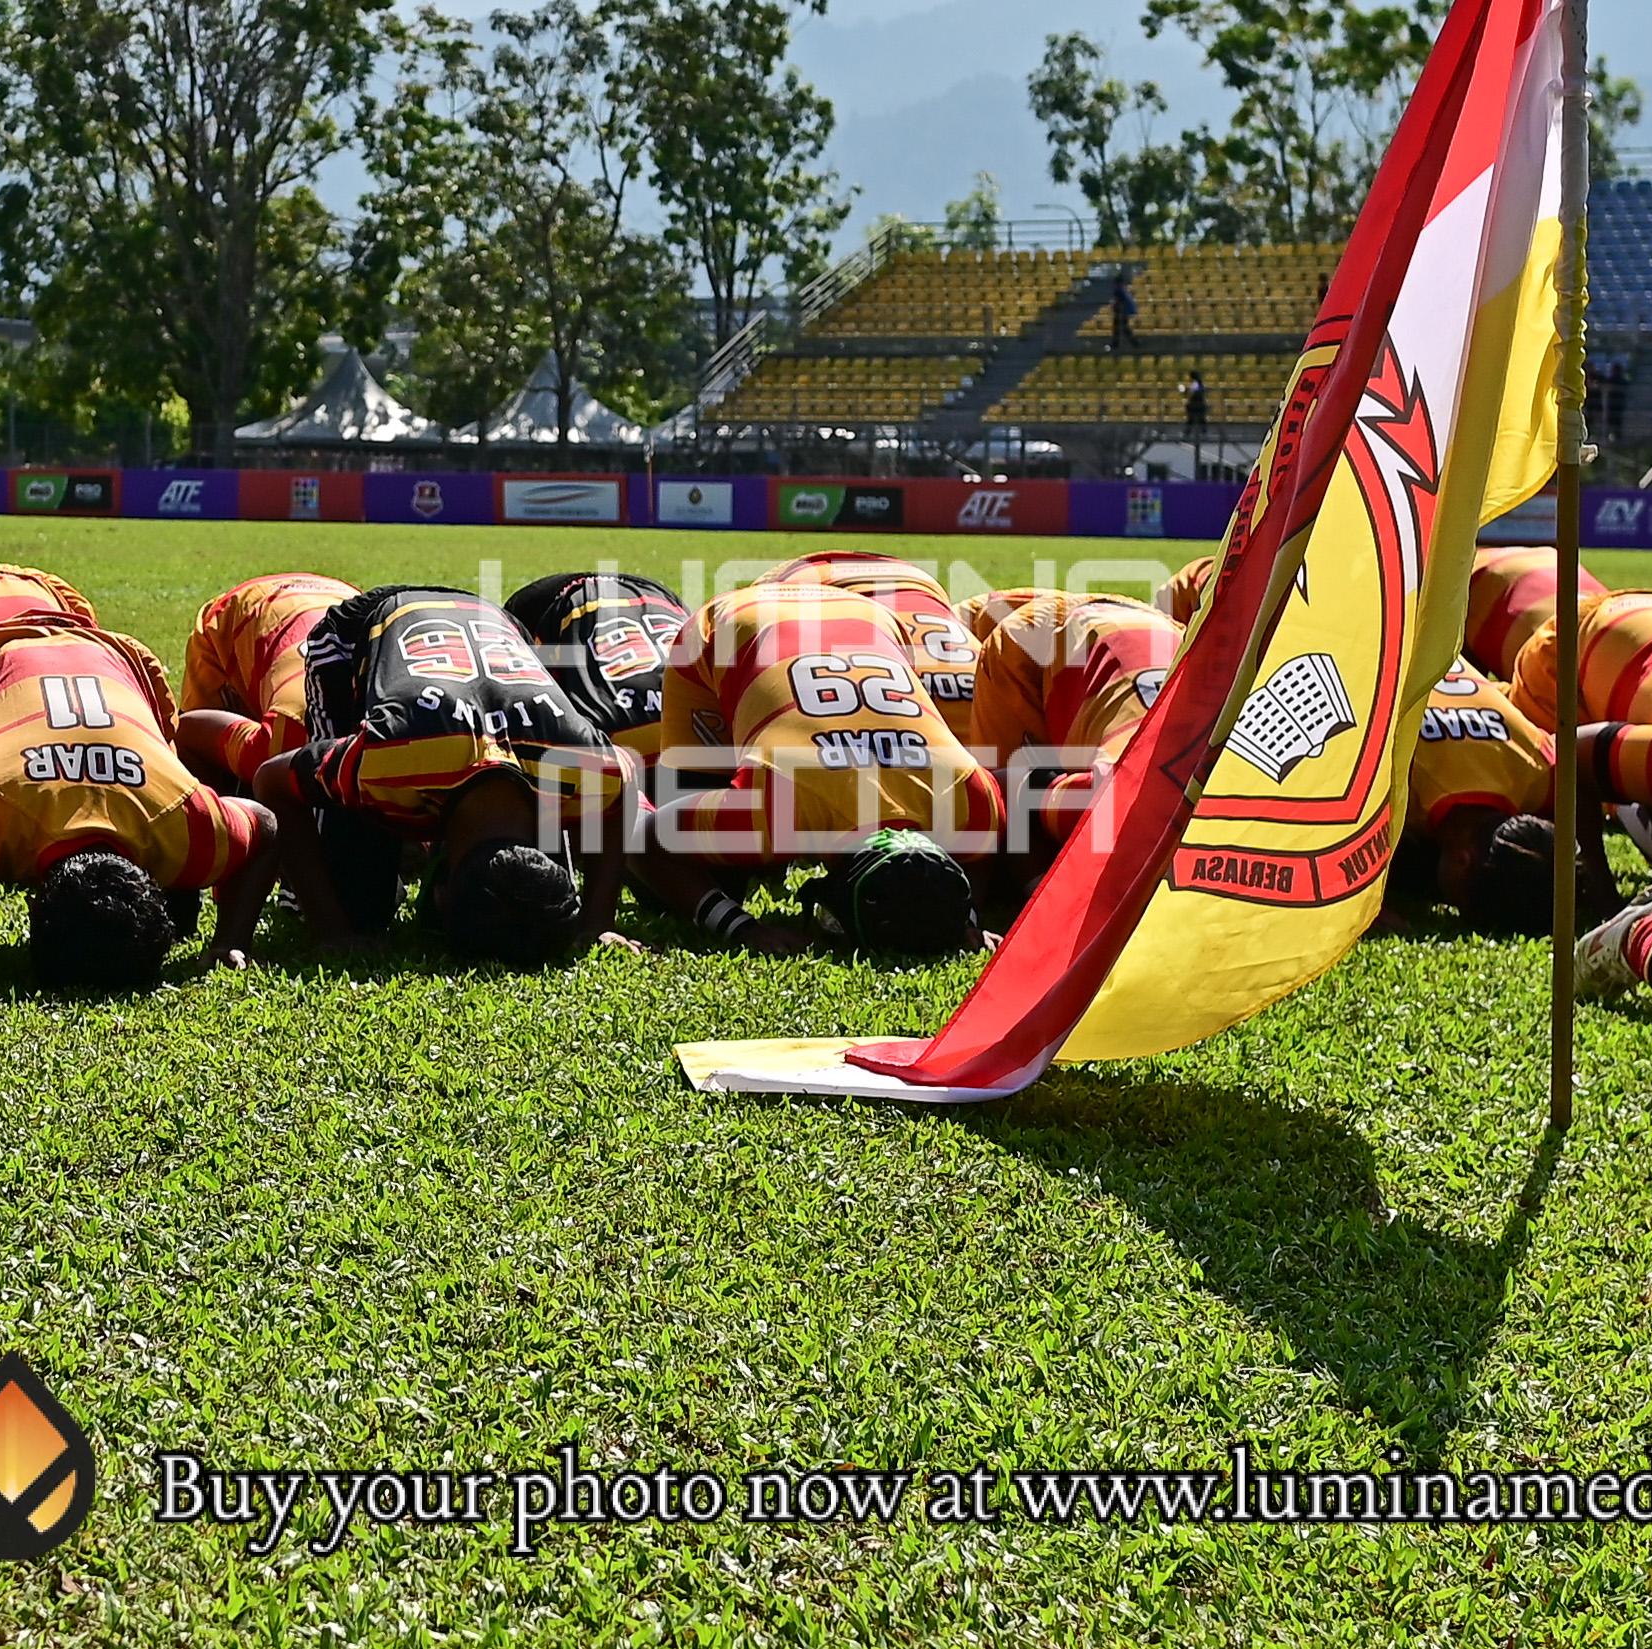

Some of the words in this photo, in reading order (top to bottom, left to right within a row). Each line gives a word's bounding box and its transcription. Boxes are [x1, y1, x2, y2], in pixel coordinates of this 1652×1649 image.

[40, 676, 115, 729] 11
[417, 686, 565, 734] LIONS
[787, 654, 923, 718] 29
[20, 743, 146, 787] SDAR
[811, 729, 931, 770] SDAR
